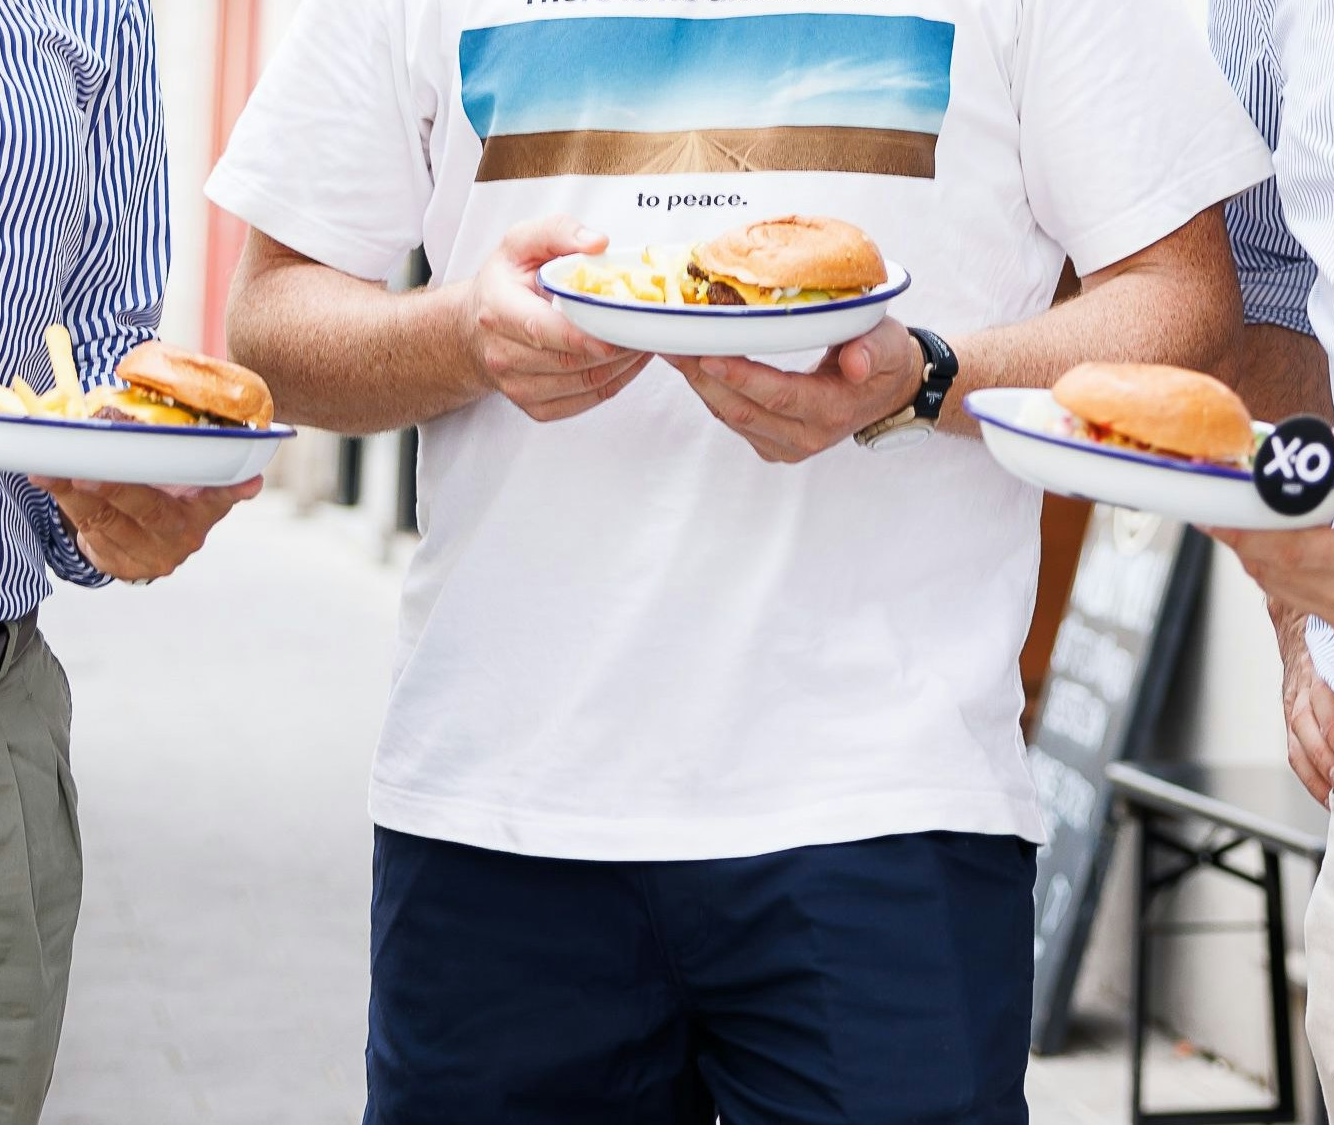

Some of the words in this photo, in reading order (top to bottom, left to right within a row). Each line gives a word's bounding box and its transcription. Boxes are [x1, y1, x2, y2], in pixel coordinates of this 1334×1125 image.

[636, 192, 661, 208] to
[667, 194, 749, 212] peace.
[1263, 435, 1332, 483] XO
